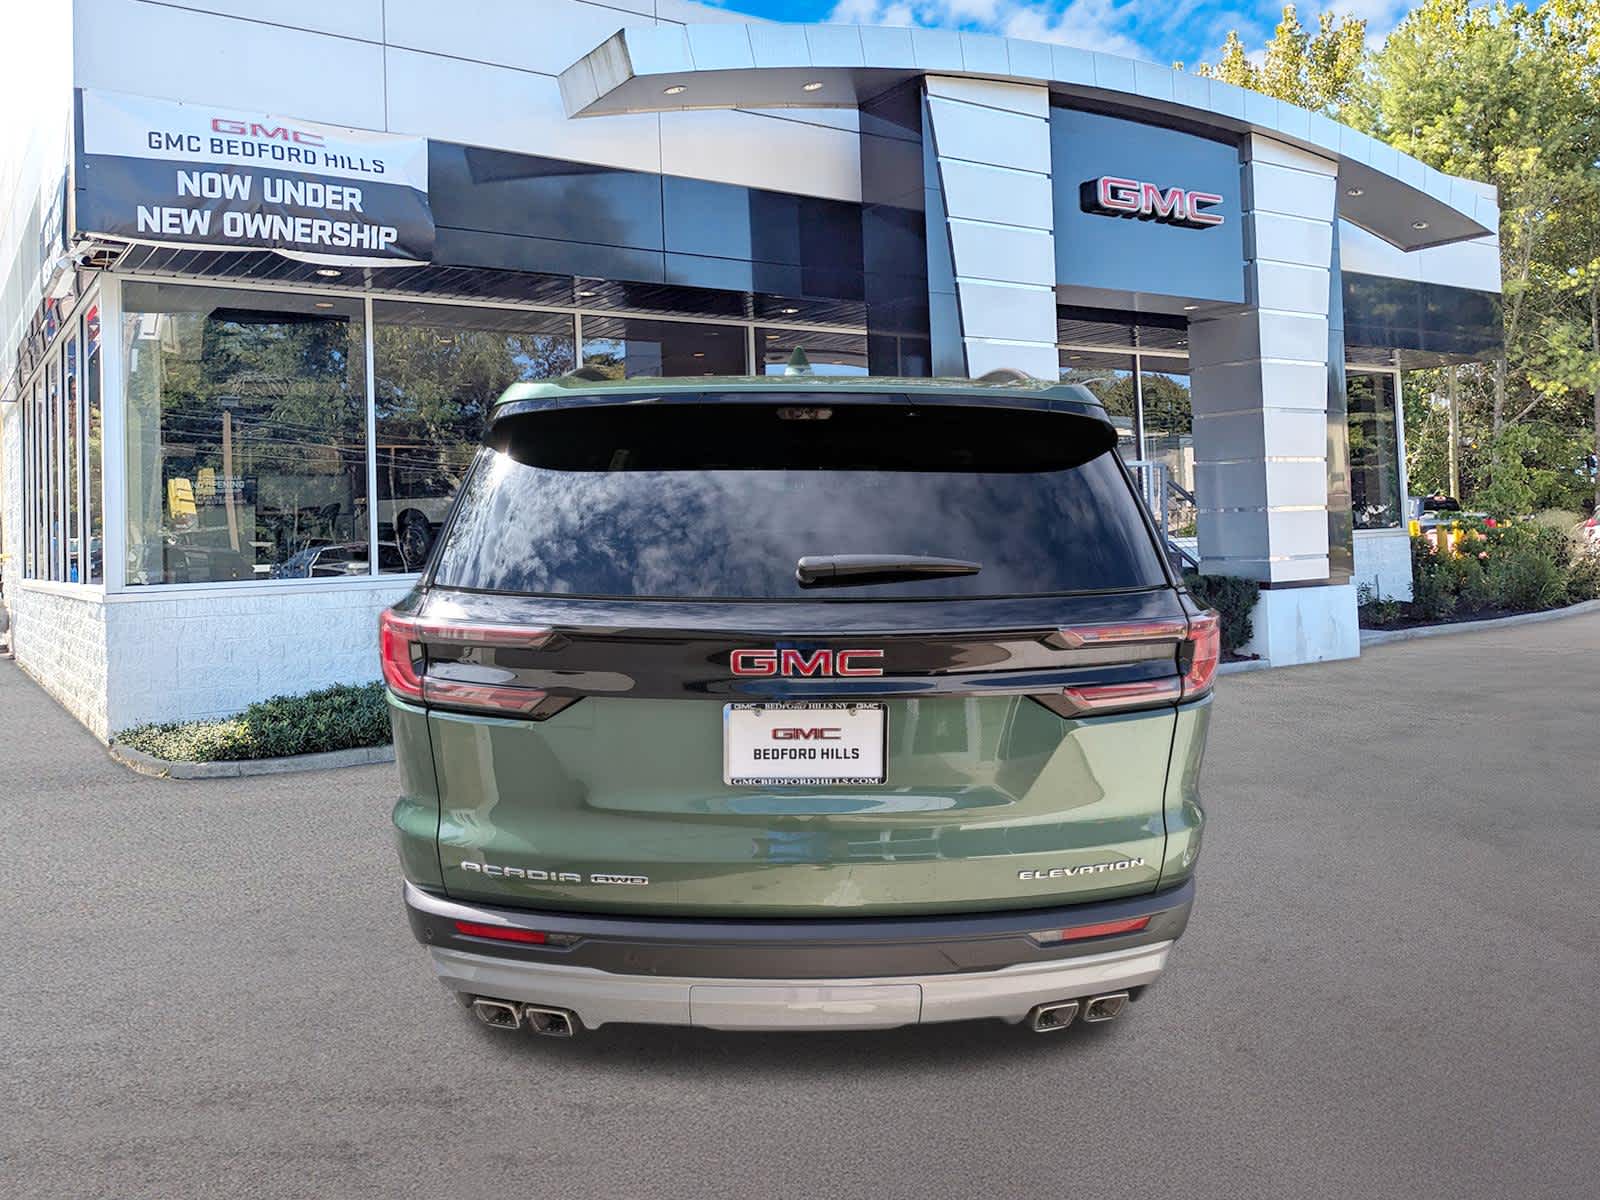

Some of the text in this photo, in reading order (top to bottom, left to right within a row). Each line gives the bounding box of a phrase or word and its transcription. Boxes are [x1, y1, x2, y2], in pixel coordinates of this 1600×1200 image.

[211, 118, 326, 147] GMC
[148, 131, 385, 174] GMC BEDFORD HILLS
[176, 171, 364, 213] NOW UNDER
[1097, 176, 1225, 224] GMC
[136, 206, 398, 250] NEW OWNERSHIP
[730, 649, 884, 677] GMC
[771, 727, 842, 740] GMC
[753, 748, 860, 760] BEDFORD HILLS
[460, 860, 649, 886] ACADIA AWD
[1018, 857, 1146, 881] ELEVATION
